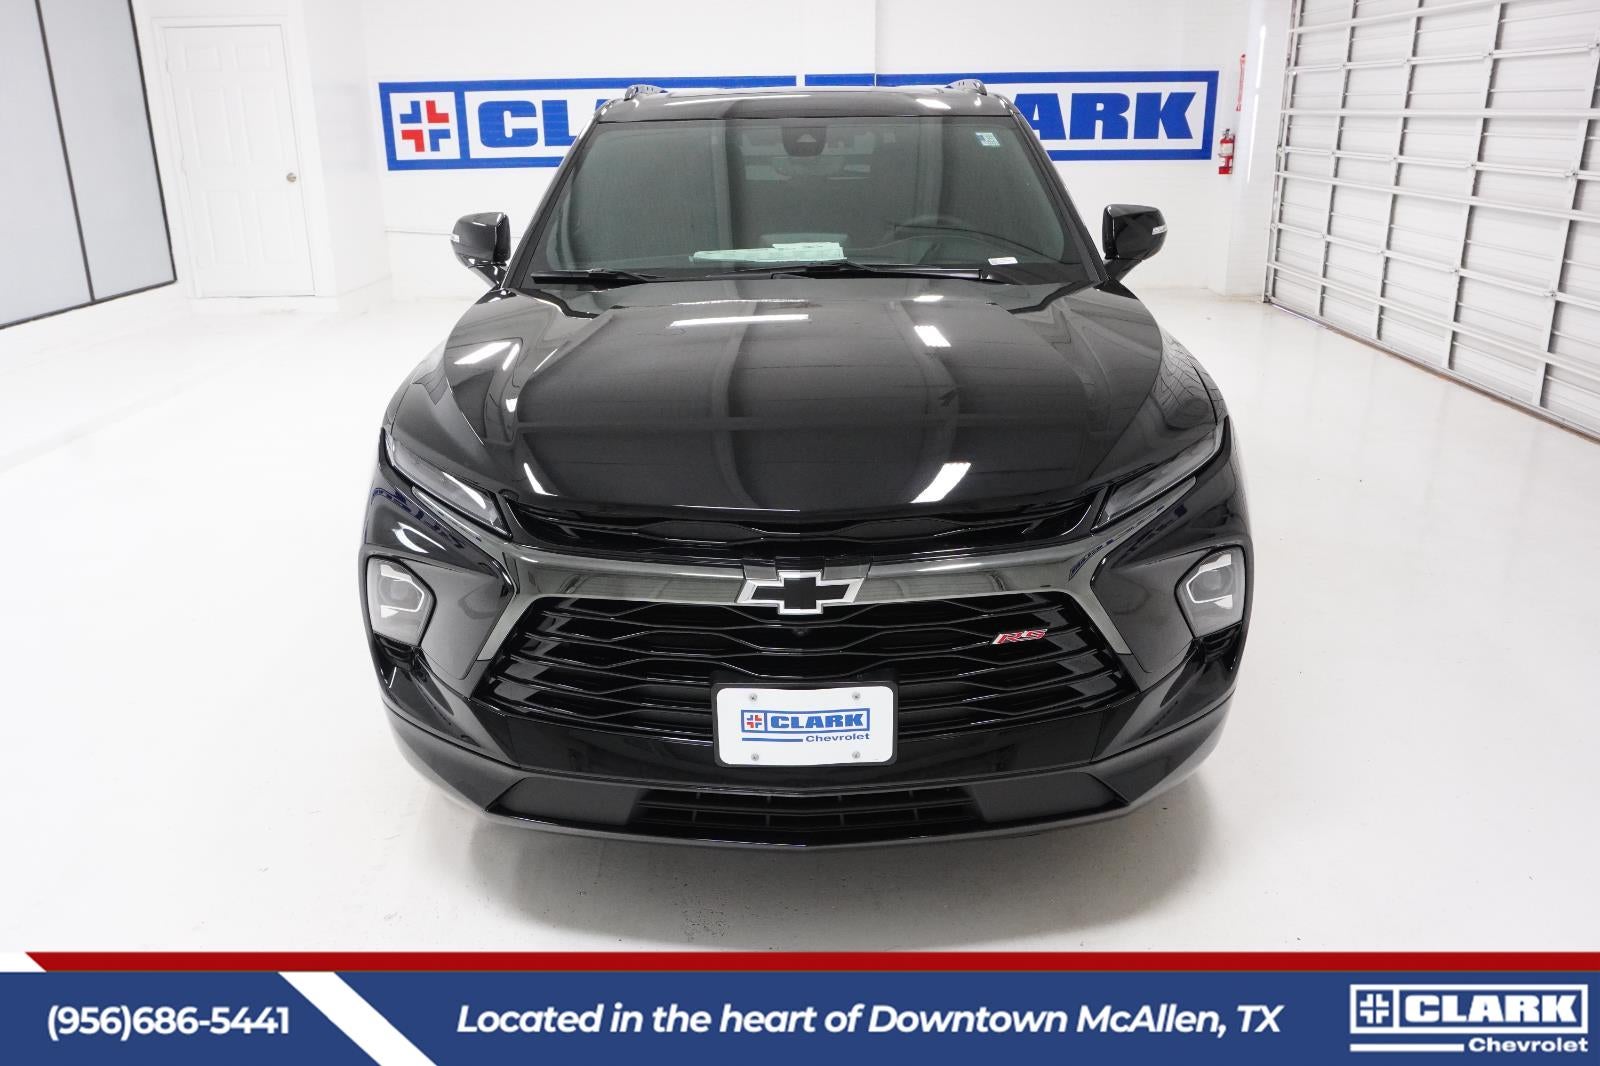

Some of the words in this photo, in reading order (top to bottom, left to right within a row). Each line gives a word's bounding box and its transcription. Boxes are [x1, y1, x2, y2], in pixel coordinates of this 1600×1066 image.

[478, 99, 611, 148] CL
[992, 629, 1047, 644] RS
[770, 713, 864, 729] CLARK
[805, 732, 870, 743] Chevrolet
